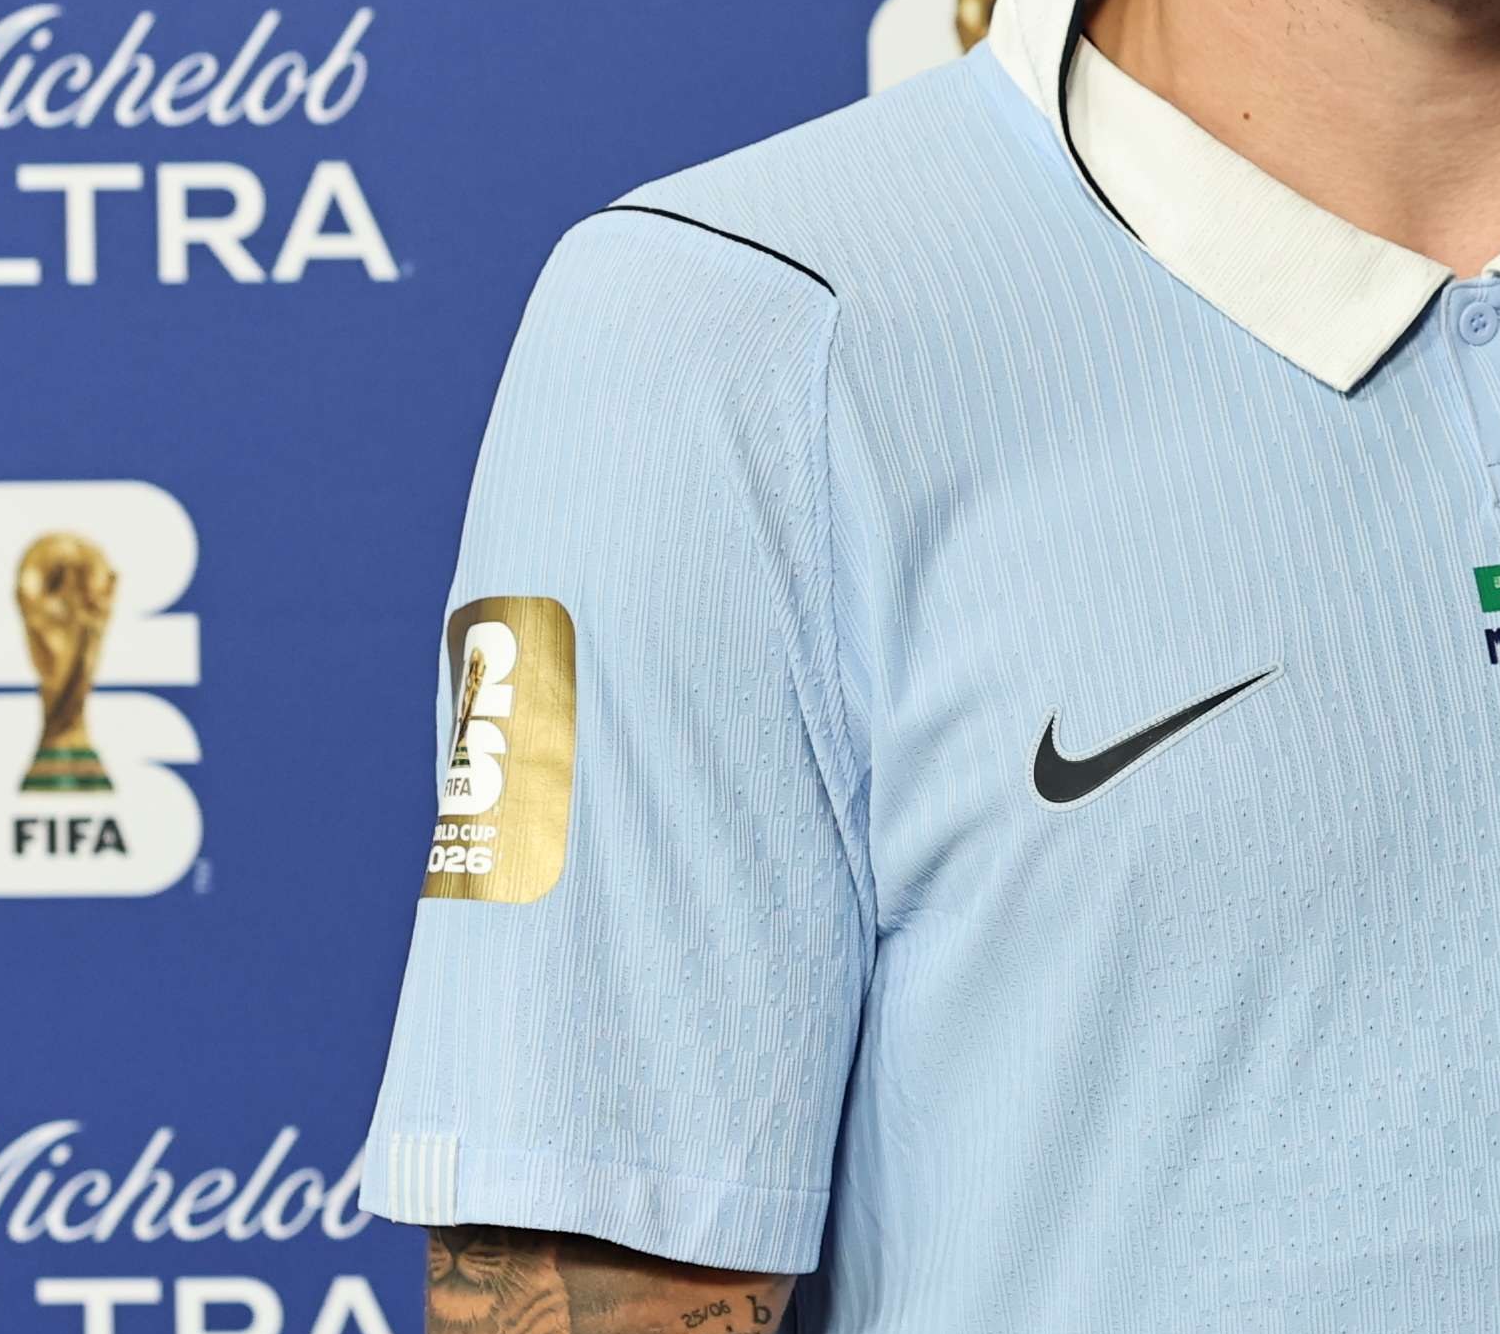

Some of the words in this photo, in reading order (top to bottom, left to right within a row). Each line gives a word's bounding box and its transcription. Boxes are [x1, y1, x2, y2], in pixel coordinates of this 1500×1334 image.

[11, 815, 129, 857] FIFA
[459, 823, 498, 842] CUP
[426, 844, 494, 875] 026
